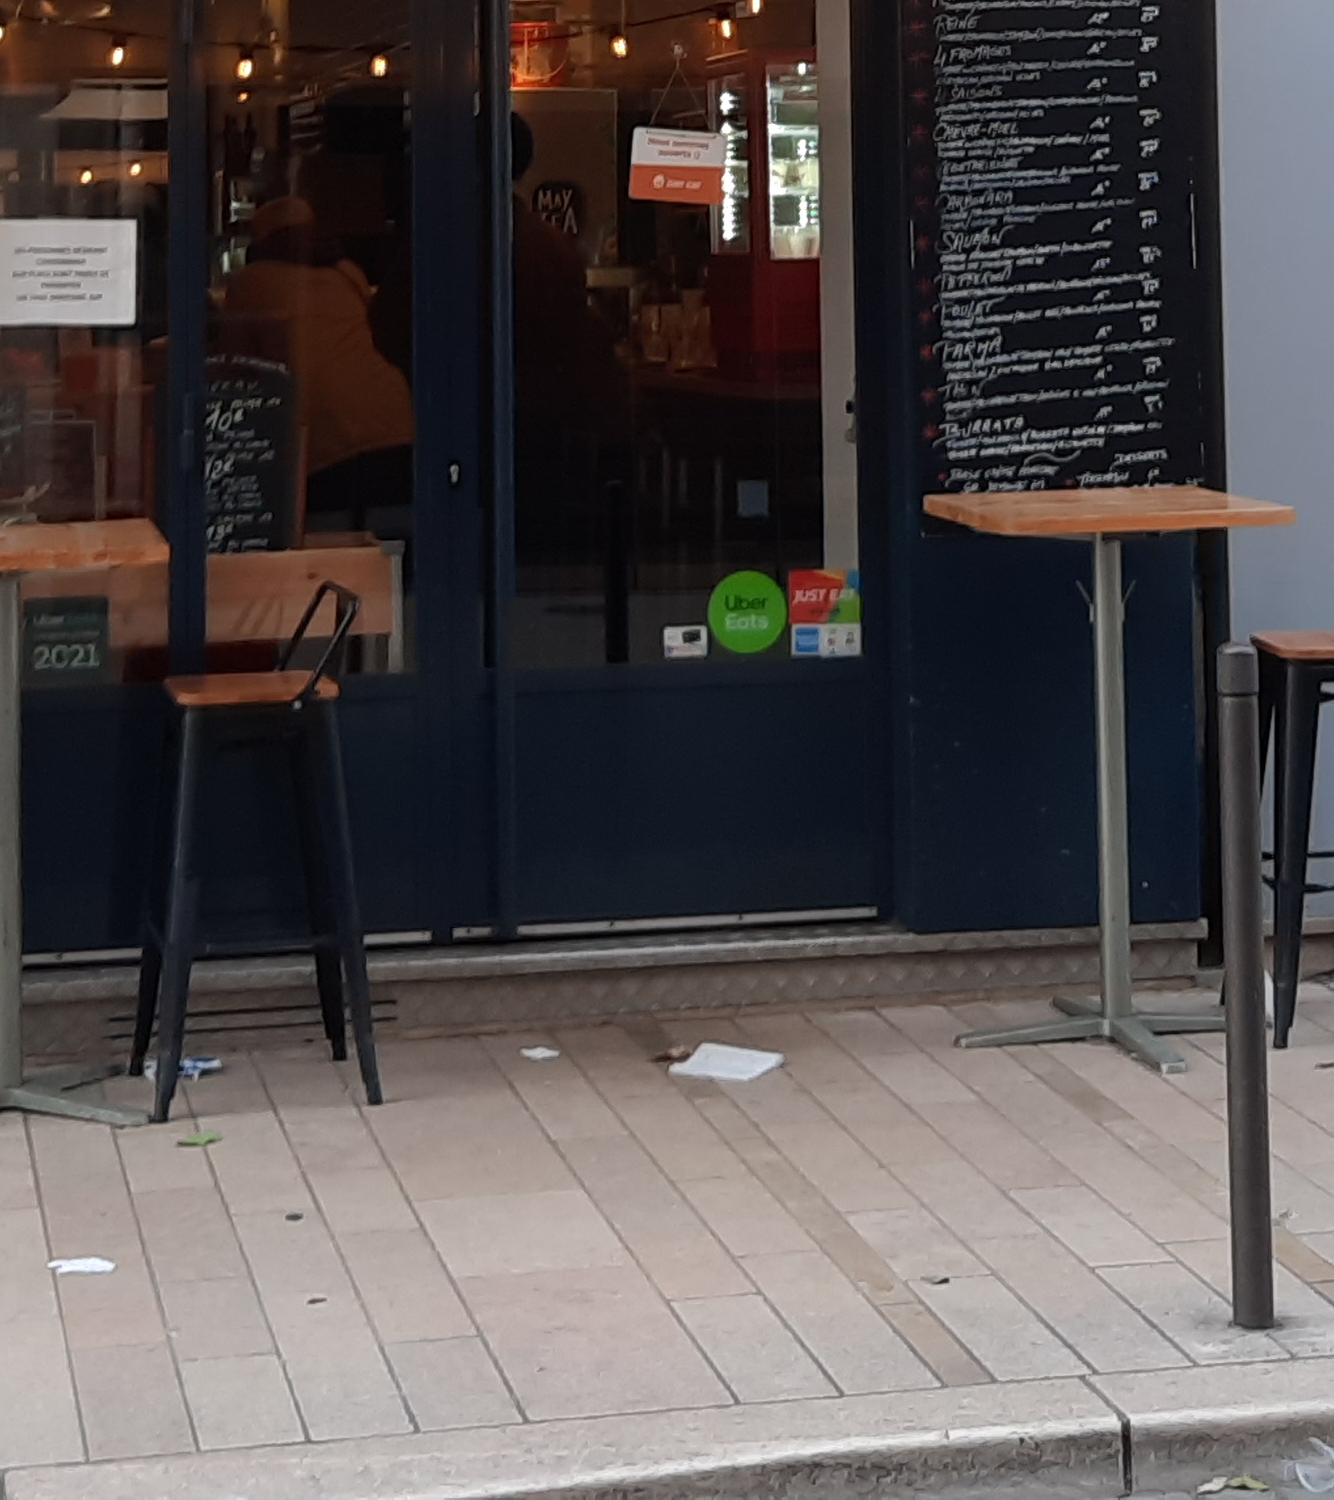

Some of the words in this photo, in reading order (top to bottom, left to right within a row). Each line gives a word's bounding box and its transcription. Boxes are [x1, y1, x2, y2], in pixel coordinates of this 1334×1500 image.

[725, 594, 768, 611] Uber
[725, 613, 769, 630] Eats
[33, 644, 99, 670] 2021
